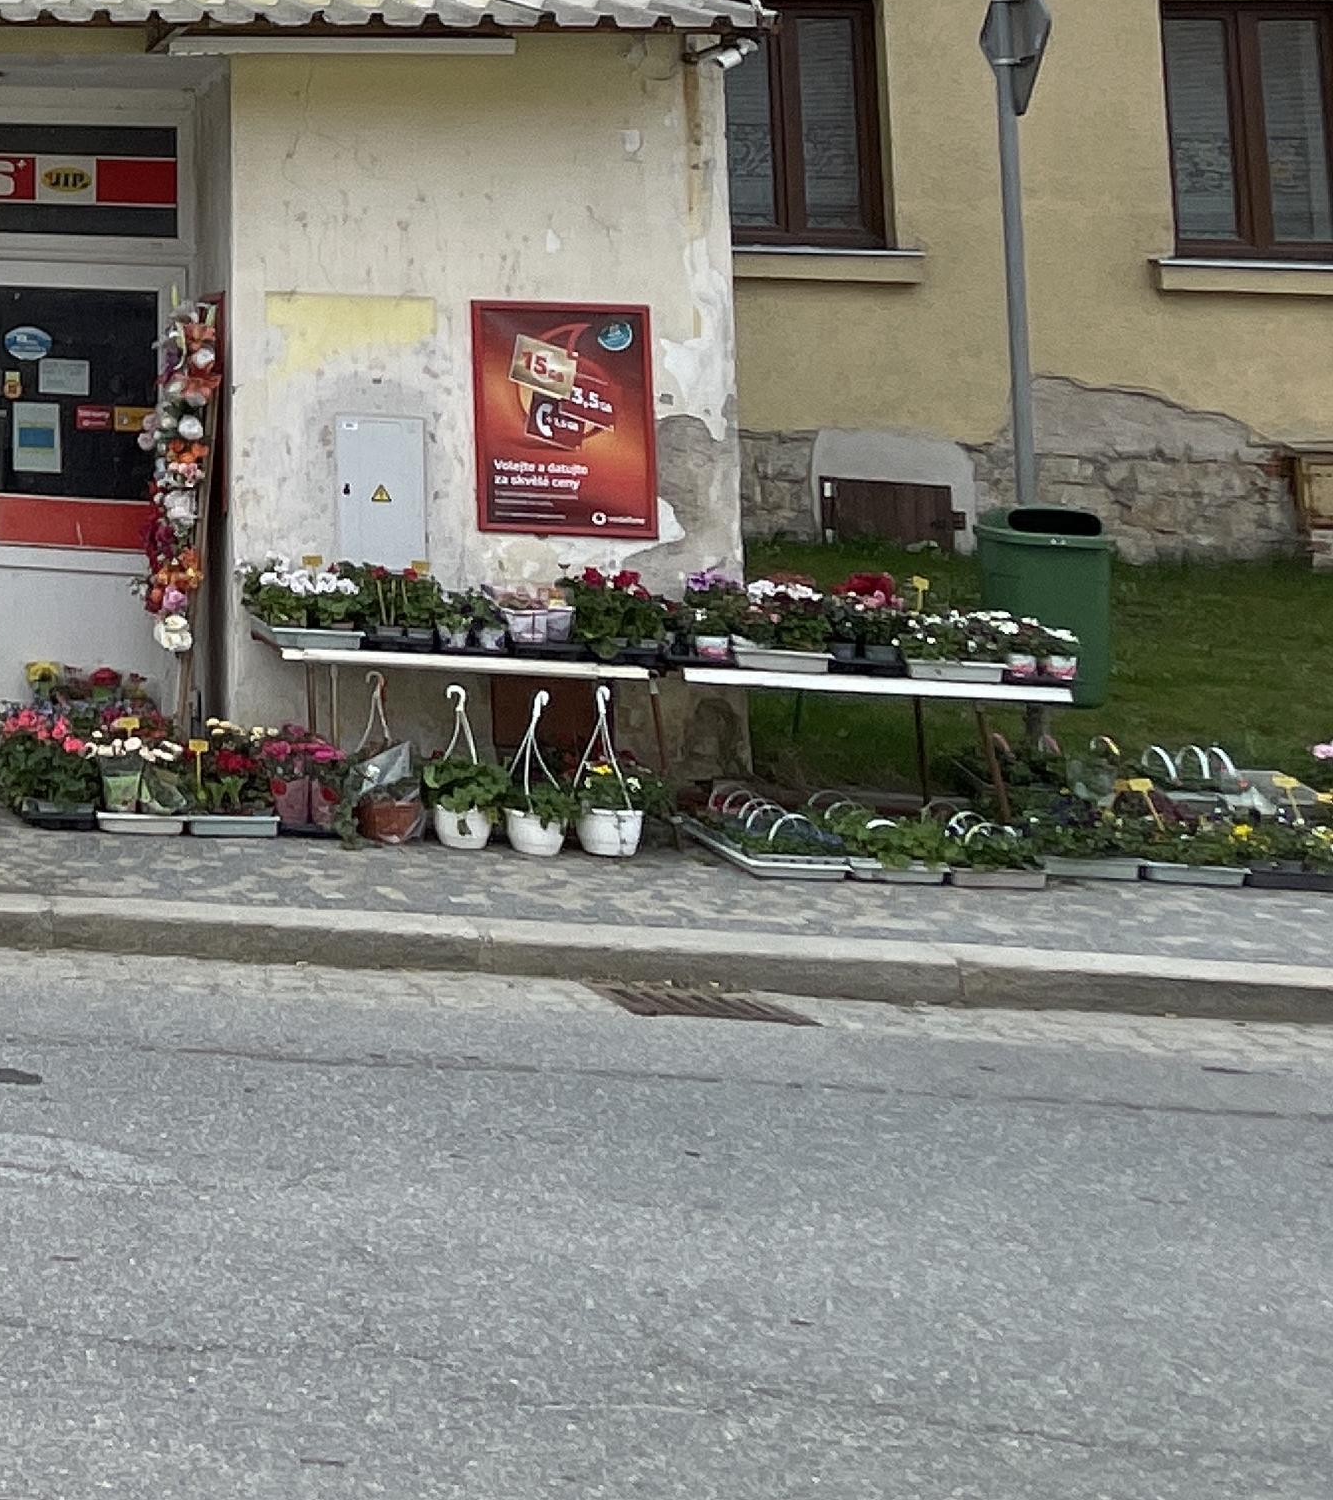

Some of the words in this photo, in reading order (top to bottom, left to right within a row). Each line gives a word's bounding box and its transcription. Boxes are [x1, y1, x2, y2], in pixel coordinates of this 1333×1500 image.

[46, 171, 87, 188] JIP
[493, 458, 536, 474] Volejte
[537, 463, 545, 473] a
[547, 462, 589, 476] datujte
[494, 475, 509, 485] za
[551, 478, 581, 491] ceny
